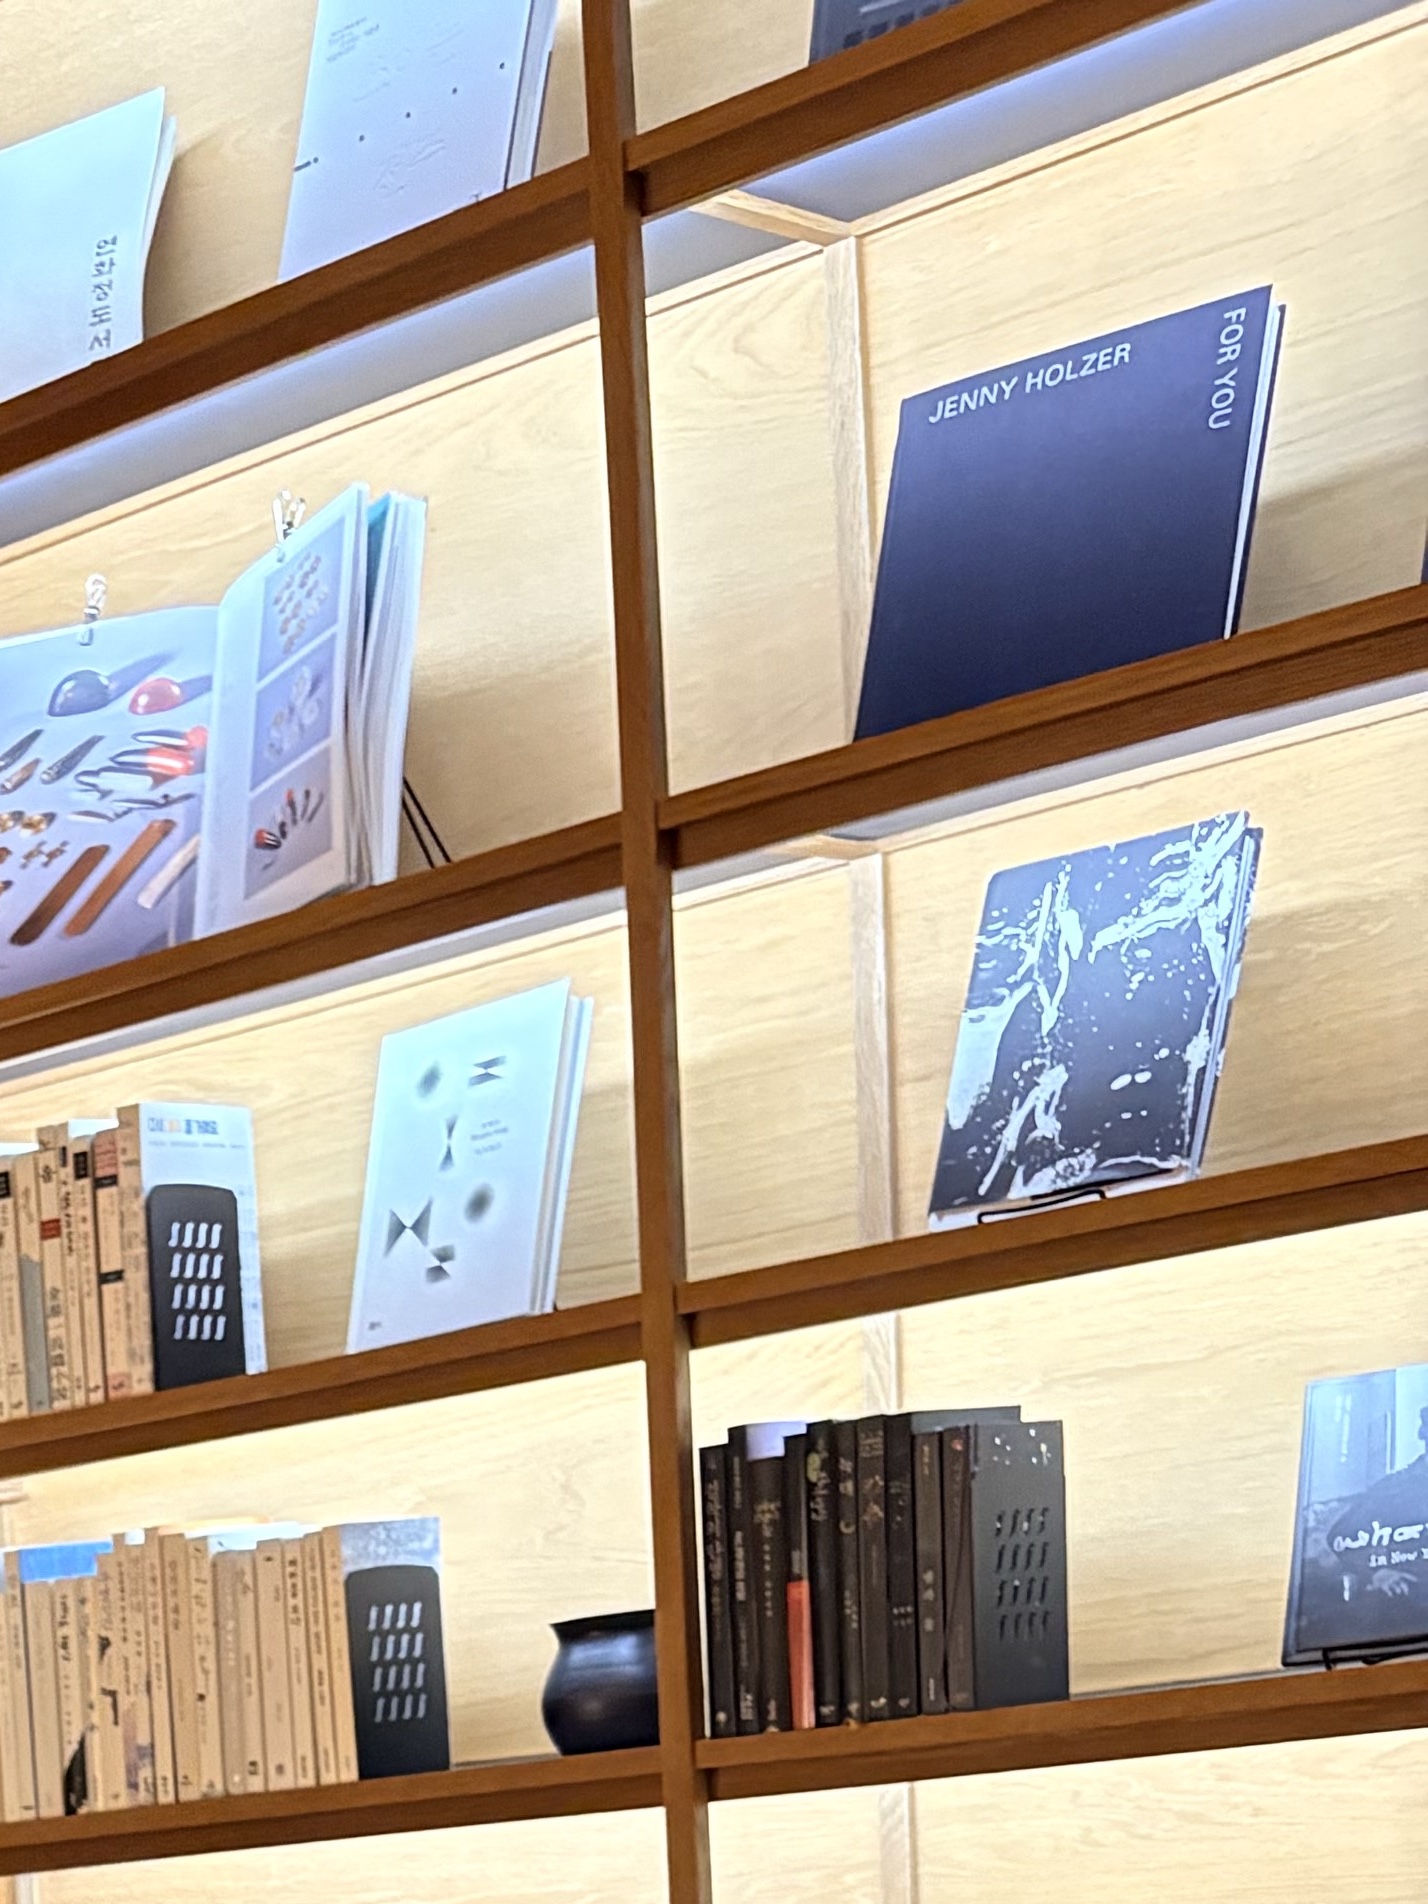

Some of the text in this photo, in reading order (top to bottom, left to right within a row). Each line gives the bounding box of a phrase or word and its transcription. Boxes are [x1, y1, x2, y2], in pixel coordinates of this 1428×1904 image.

[929, 342, 1131, 424] JENNY HOLZER
[1208, 307, 1246, 430] FOR YOU
